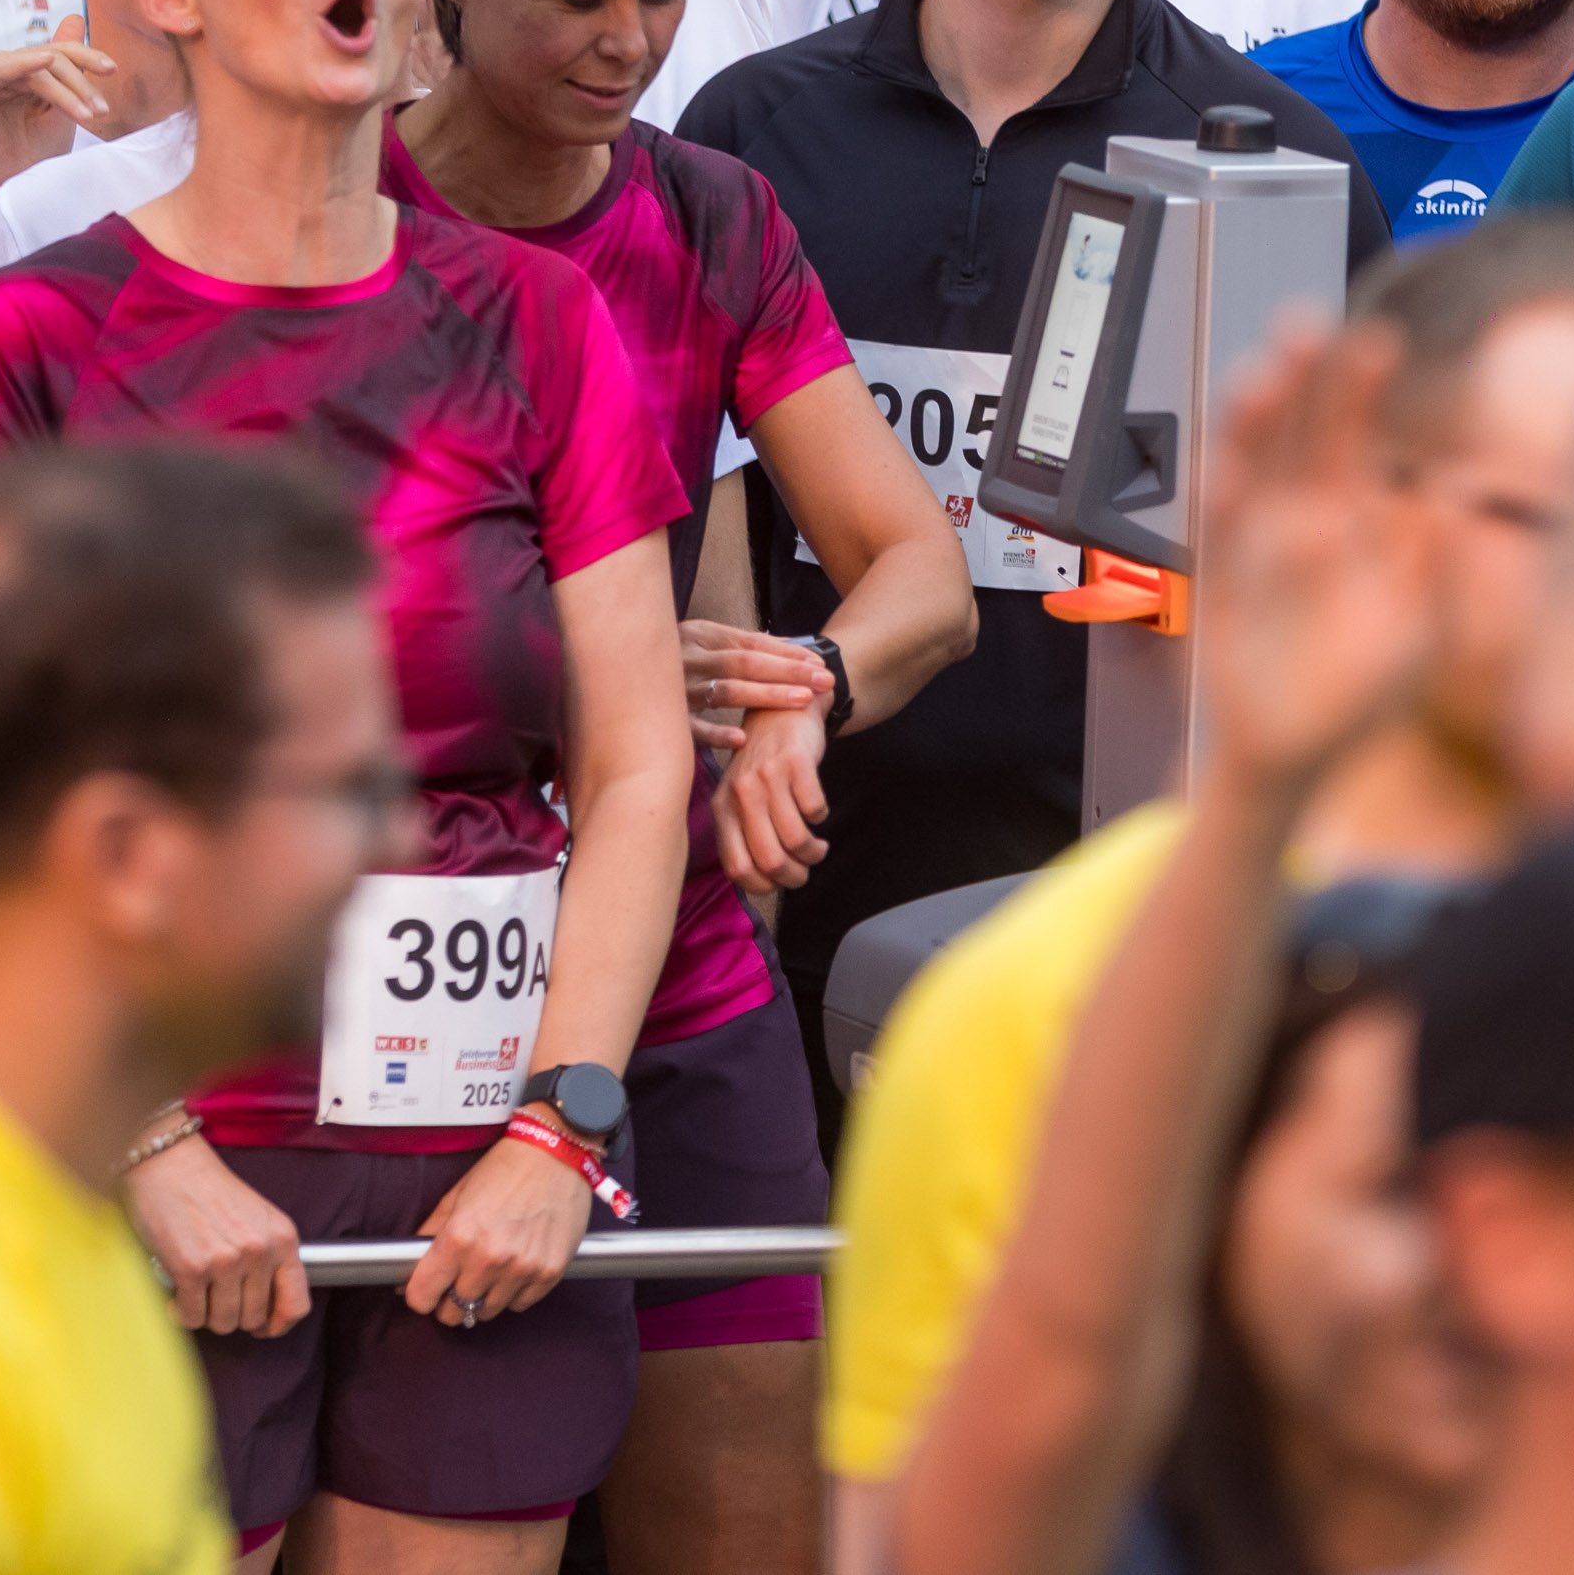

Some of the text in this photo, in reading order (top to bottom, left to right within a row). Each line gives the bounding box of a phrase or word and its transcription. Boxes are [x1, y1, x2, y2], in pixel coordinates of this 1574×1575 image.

[1415, 198, 1487, 217] skinfit
[384, 917, 549, 1003] 399A
[461, 1081, 511, 1108] 2025
